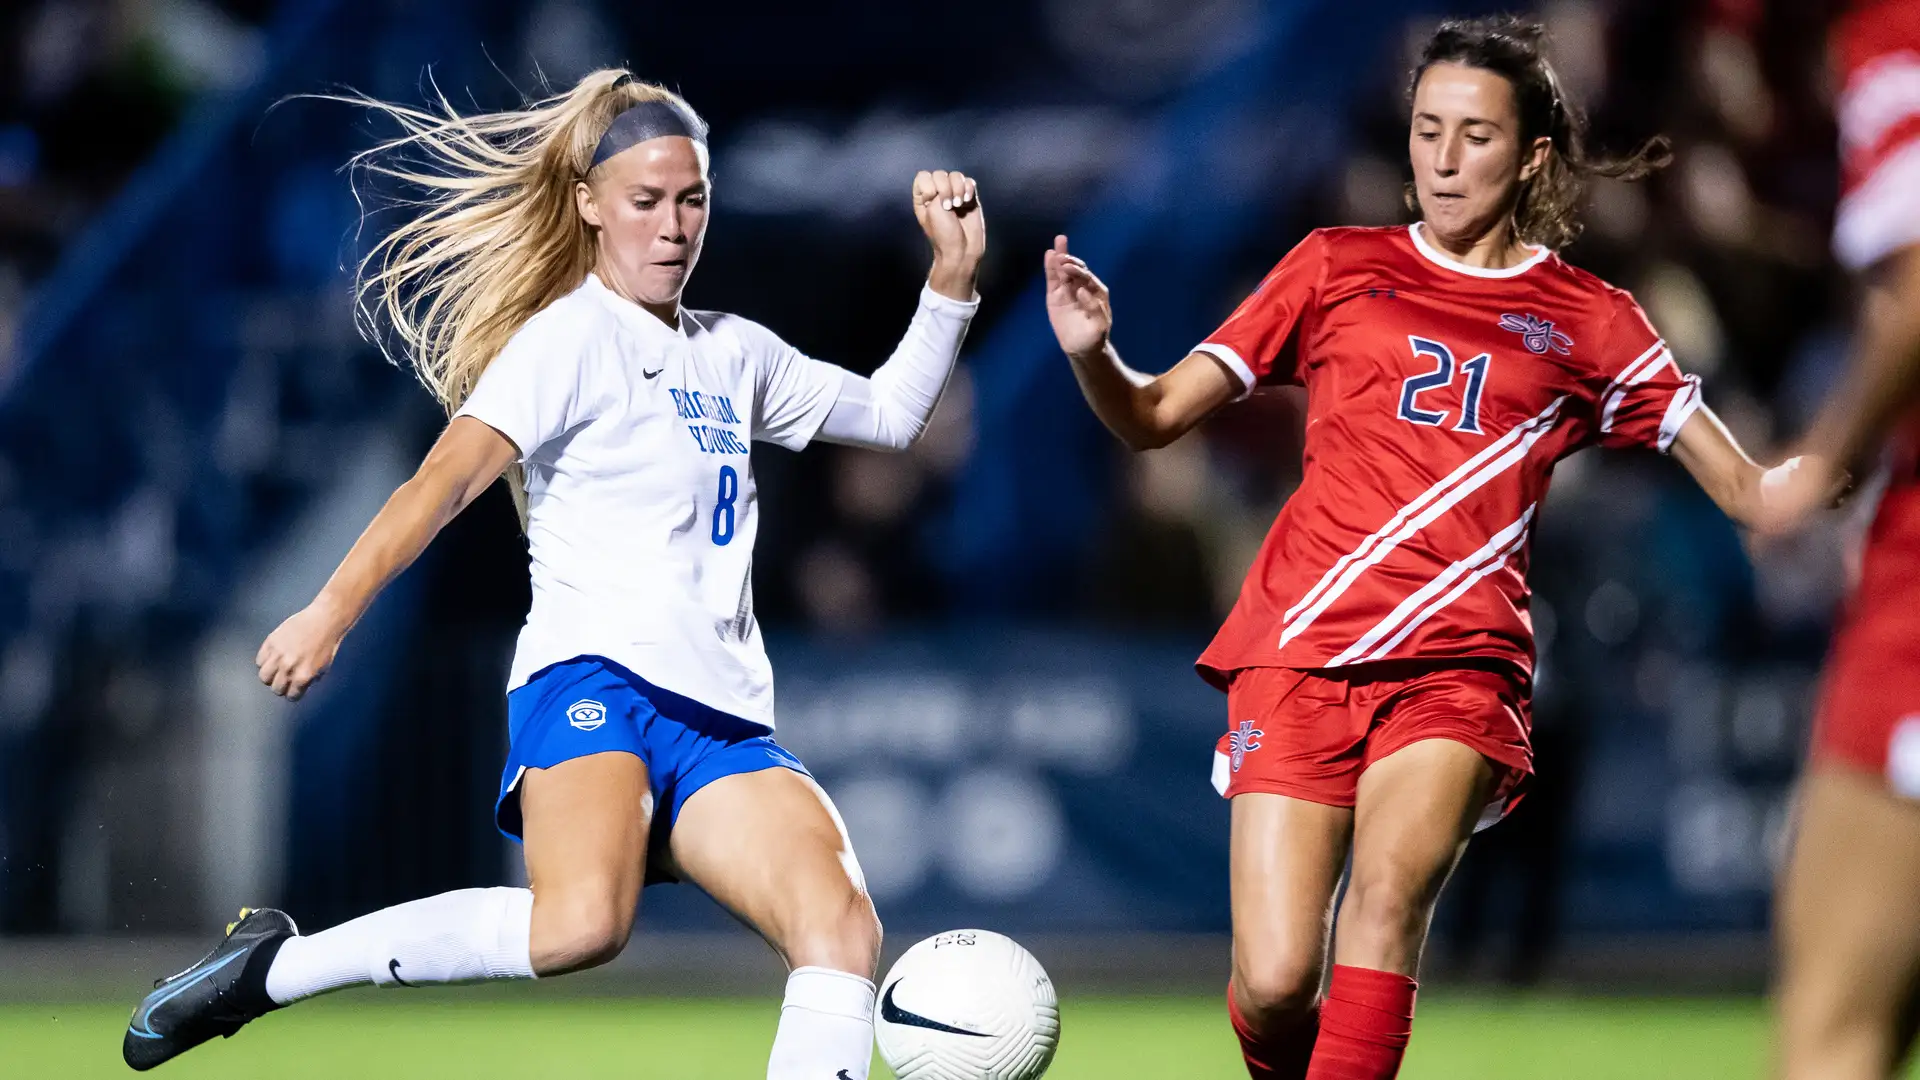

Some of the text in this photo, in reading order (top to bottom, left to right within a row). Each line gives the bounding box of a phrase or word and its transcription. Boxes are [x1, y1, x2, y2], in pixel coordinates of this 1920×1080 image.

[668, 388, 742, 424] BRIGHAM
[1397, 335, 1492, 436] 21
[688, 425, 748, 454] YOUNG
[711, 465, 738, 546] 8
